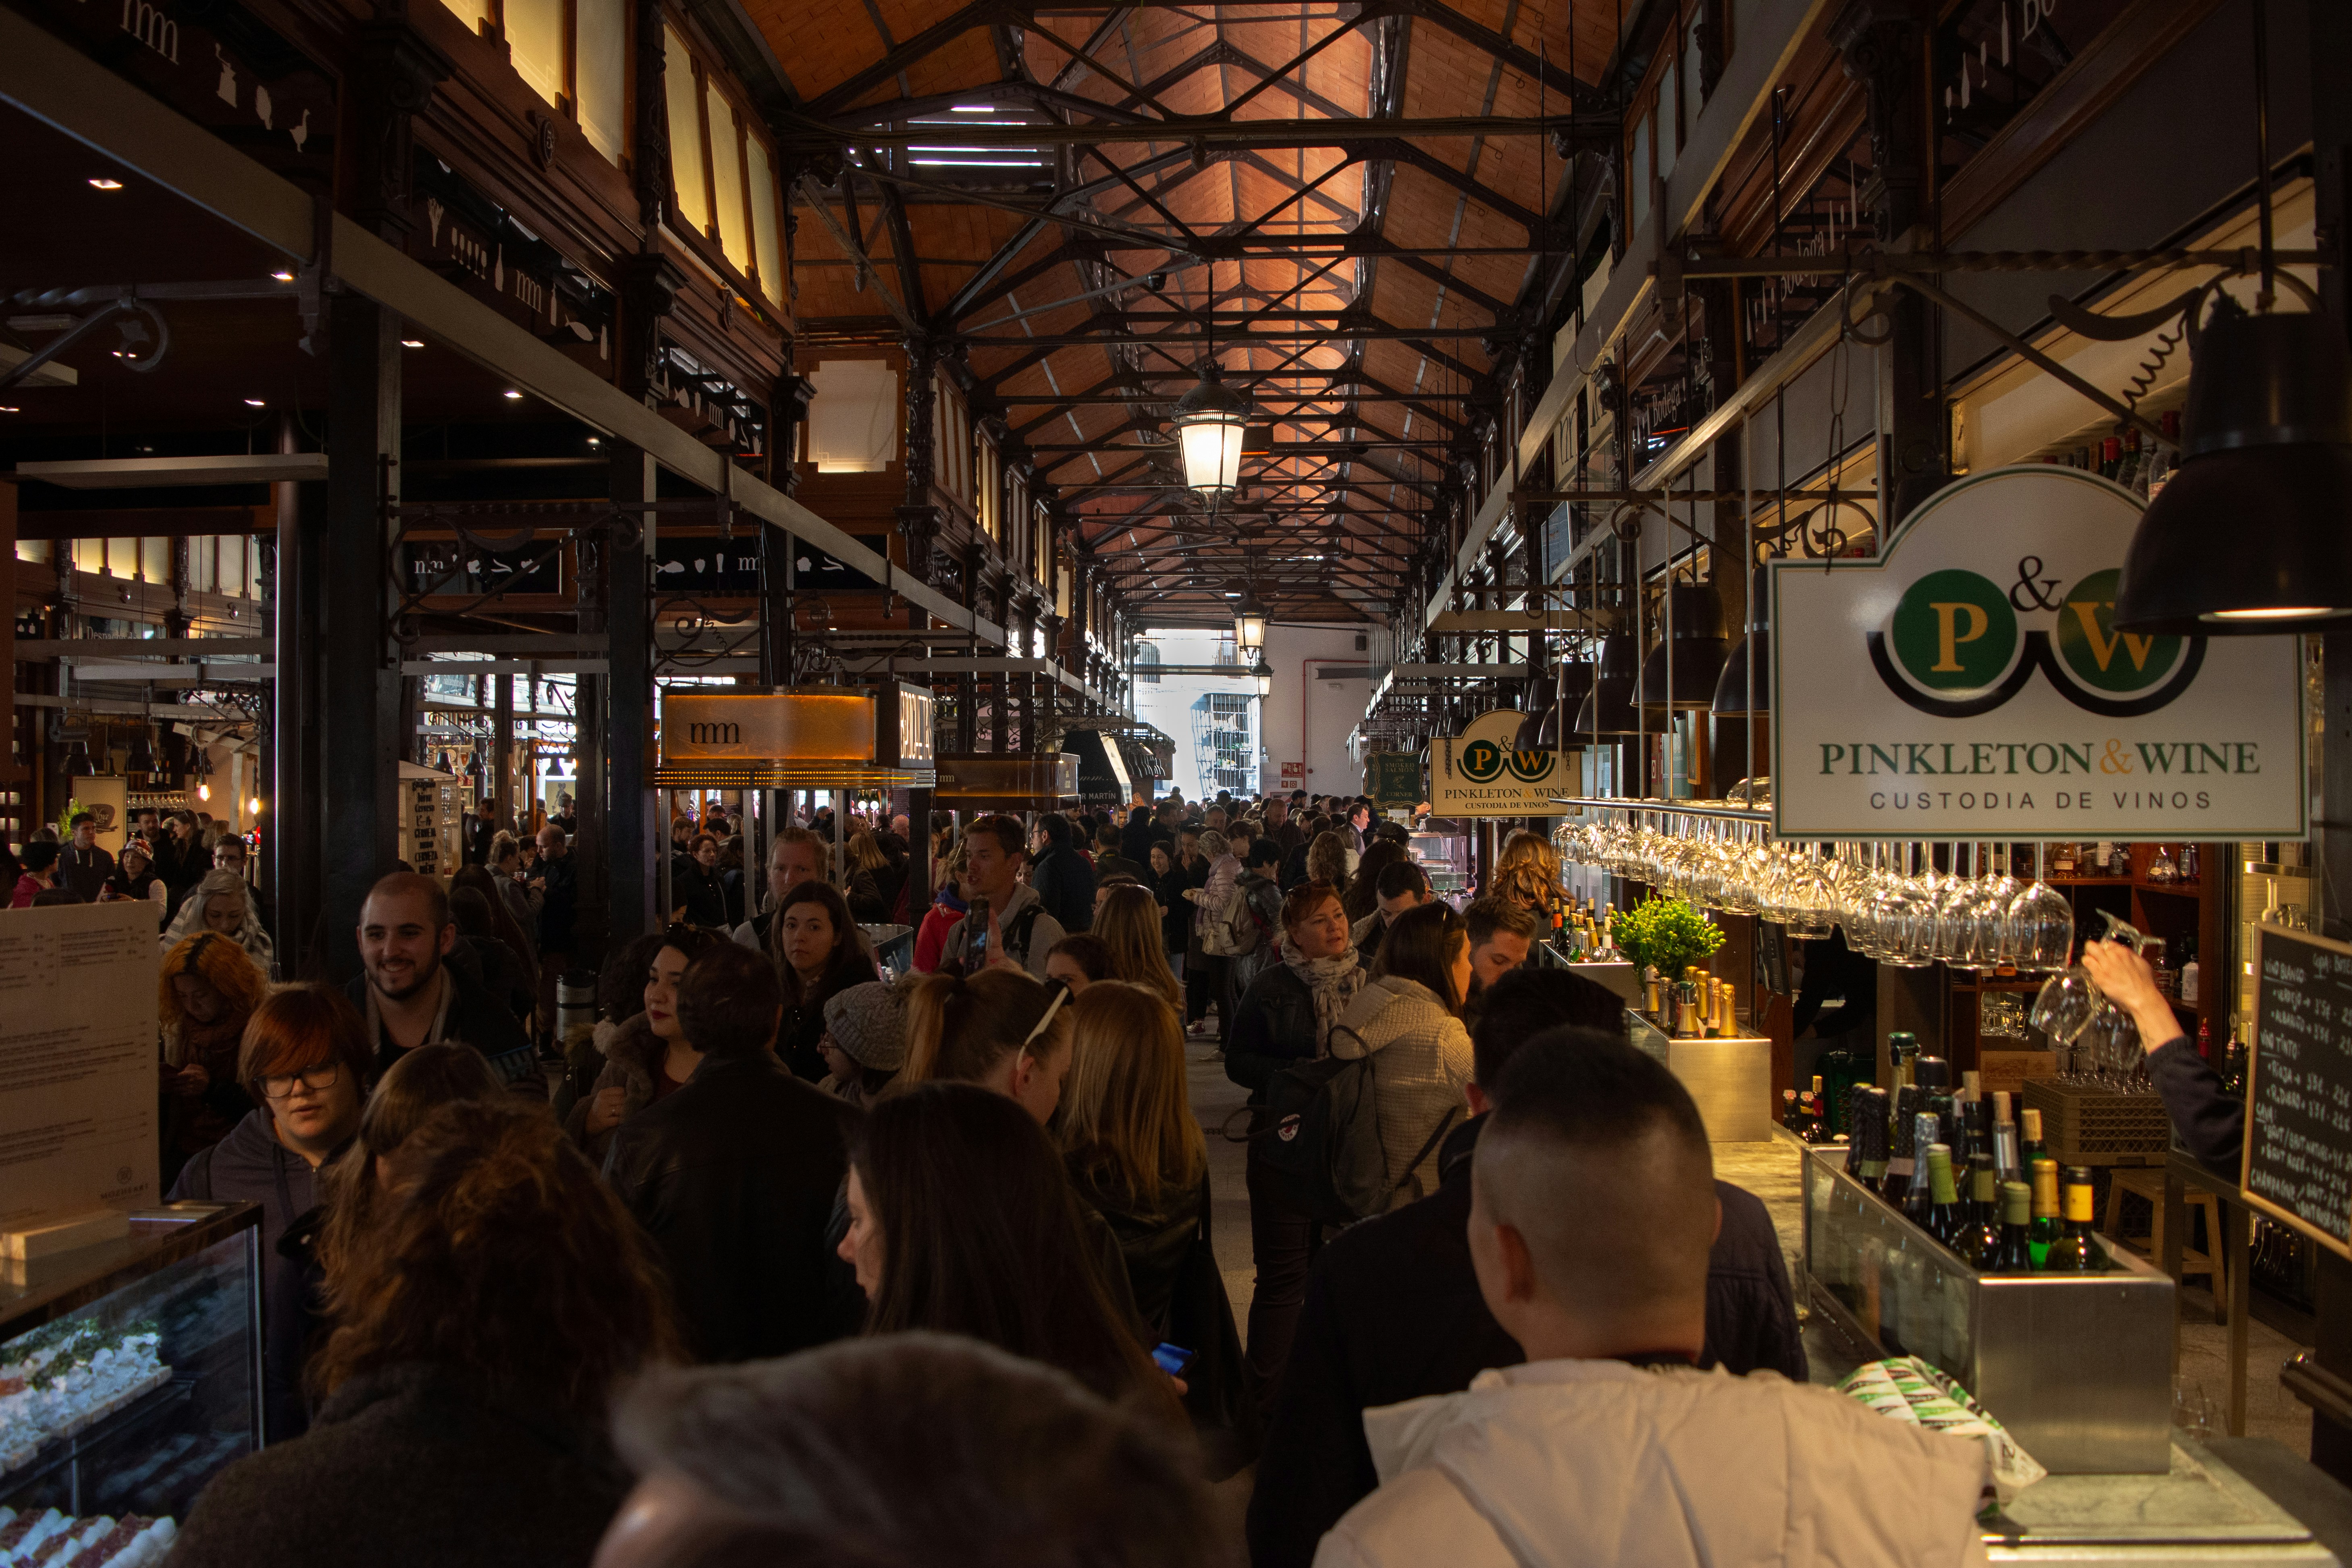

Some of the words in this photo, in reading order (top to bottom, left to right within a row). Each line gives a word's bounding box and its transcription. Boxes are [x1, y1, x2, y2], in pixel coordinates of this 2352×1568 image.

[1652, 383, 1681, 428] Bodega
[1089, 790, 1116, 800] MARTÍN
[1870, 791, 2035, 810] CUSTODIA
[2057, 791, 2092, 809] DE
[2113, 790, 2212, 810] VINOS
[1465, 802, 1507, 810] CUSTODIA
